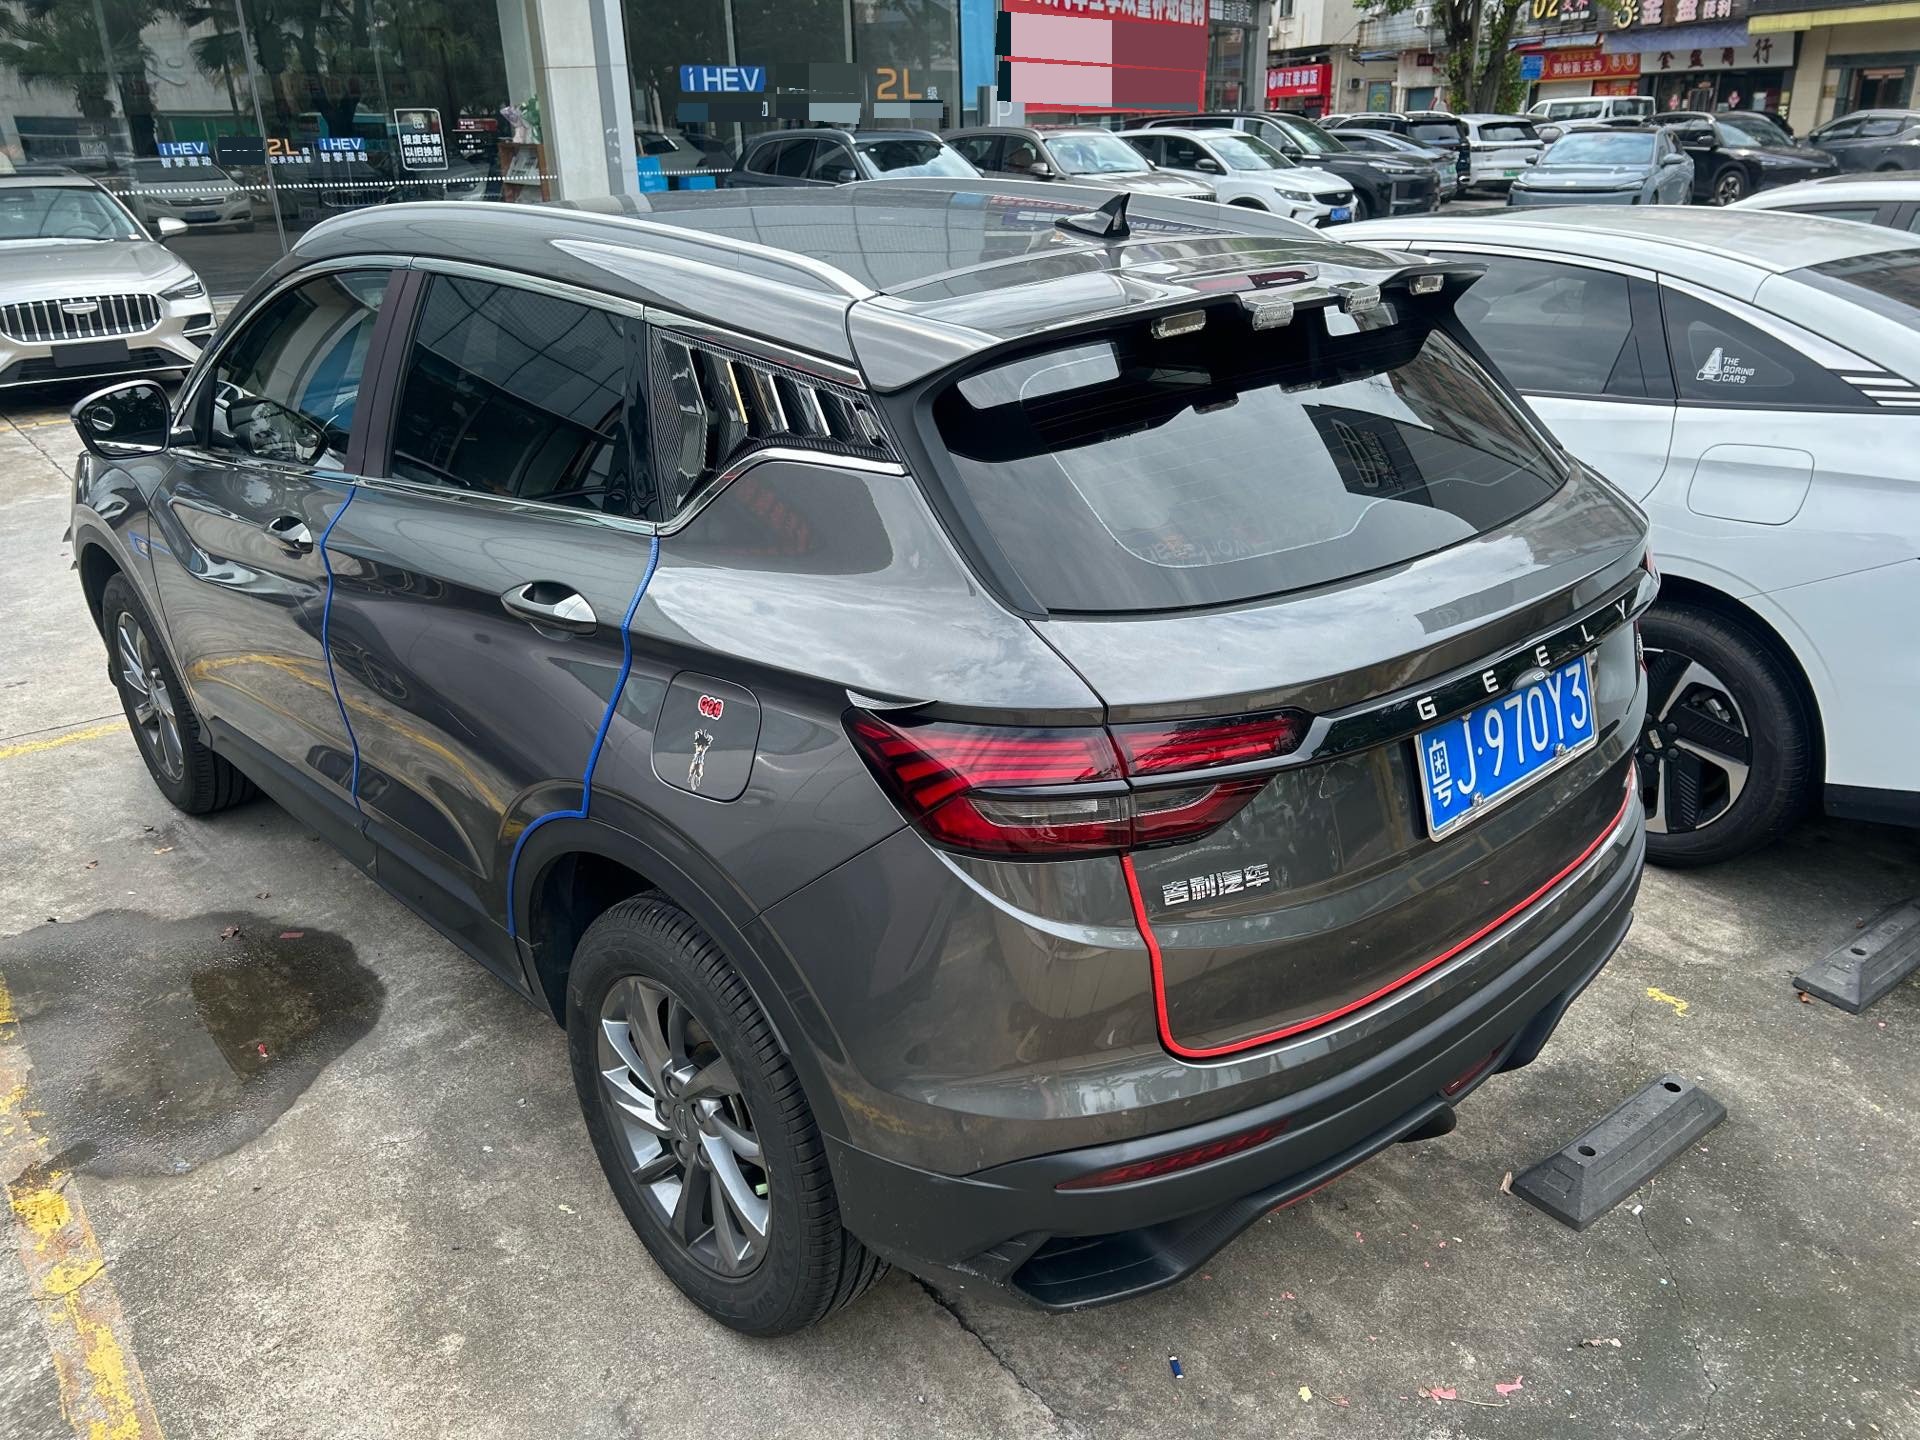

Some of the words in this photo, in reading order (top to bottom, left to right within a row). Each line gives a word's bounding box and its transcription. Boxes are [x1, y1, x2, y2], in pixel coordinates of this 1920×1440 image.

[402, 133, 441, 145] 报废车辆
[404, 146, 442, 157] 以旧换新
[1723, 356, 1740, 366] THE
[1723, 366, 1755, 376] BORING
[1722, 374, 1747, 384] CARS
[1416, 599, 1627, 721] GEELY
[1162, 863, 1271, 907] 吉利汽车
